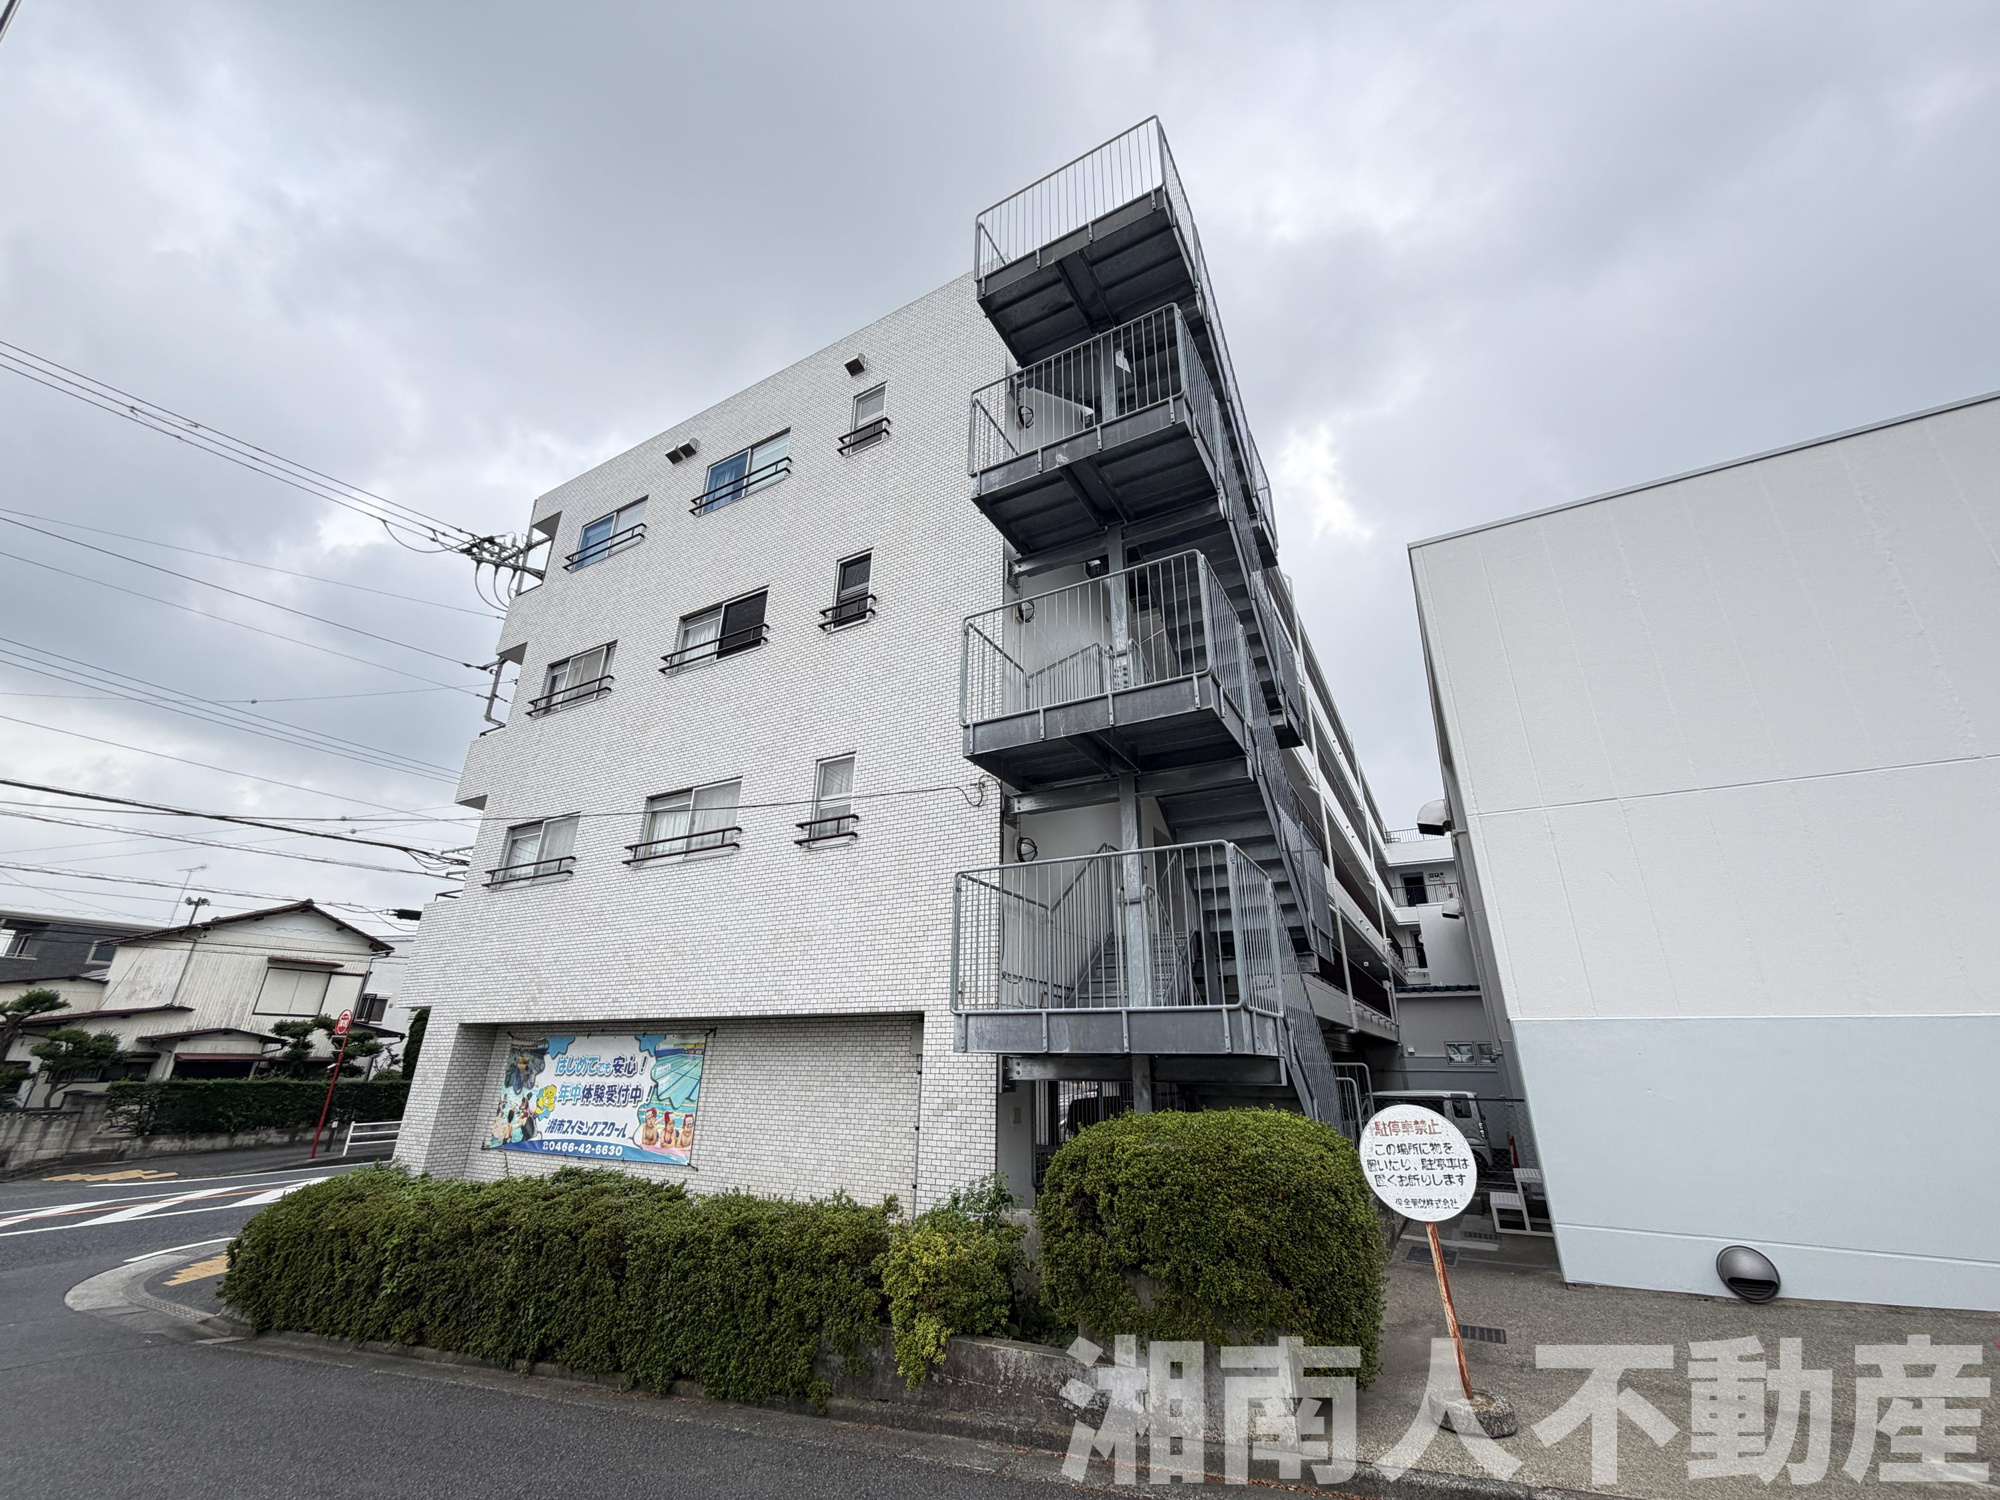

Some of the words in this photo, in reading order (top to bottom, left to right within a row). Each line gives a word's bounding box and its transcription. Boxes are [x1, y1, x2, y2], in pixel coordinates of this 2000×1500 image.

[544, 1117, 628, 1139] 湘南スイミングスクール
[1373, 1118, 1442, 1137] 駐停車禁止
[1374, 1141, 1454, 1156] この場所に物を
